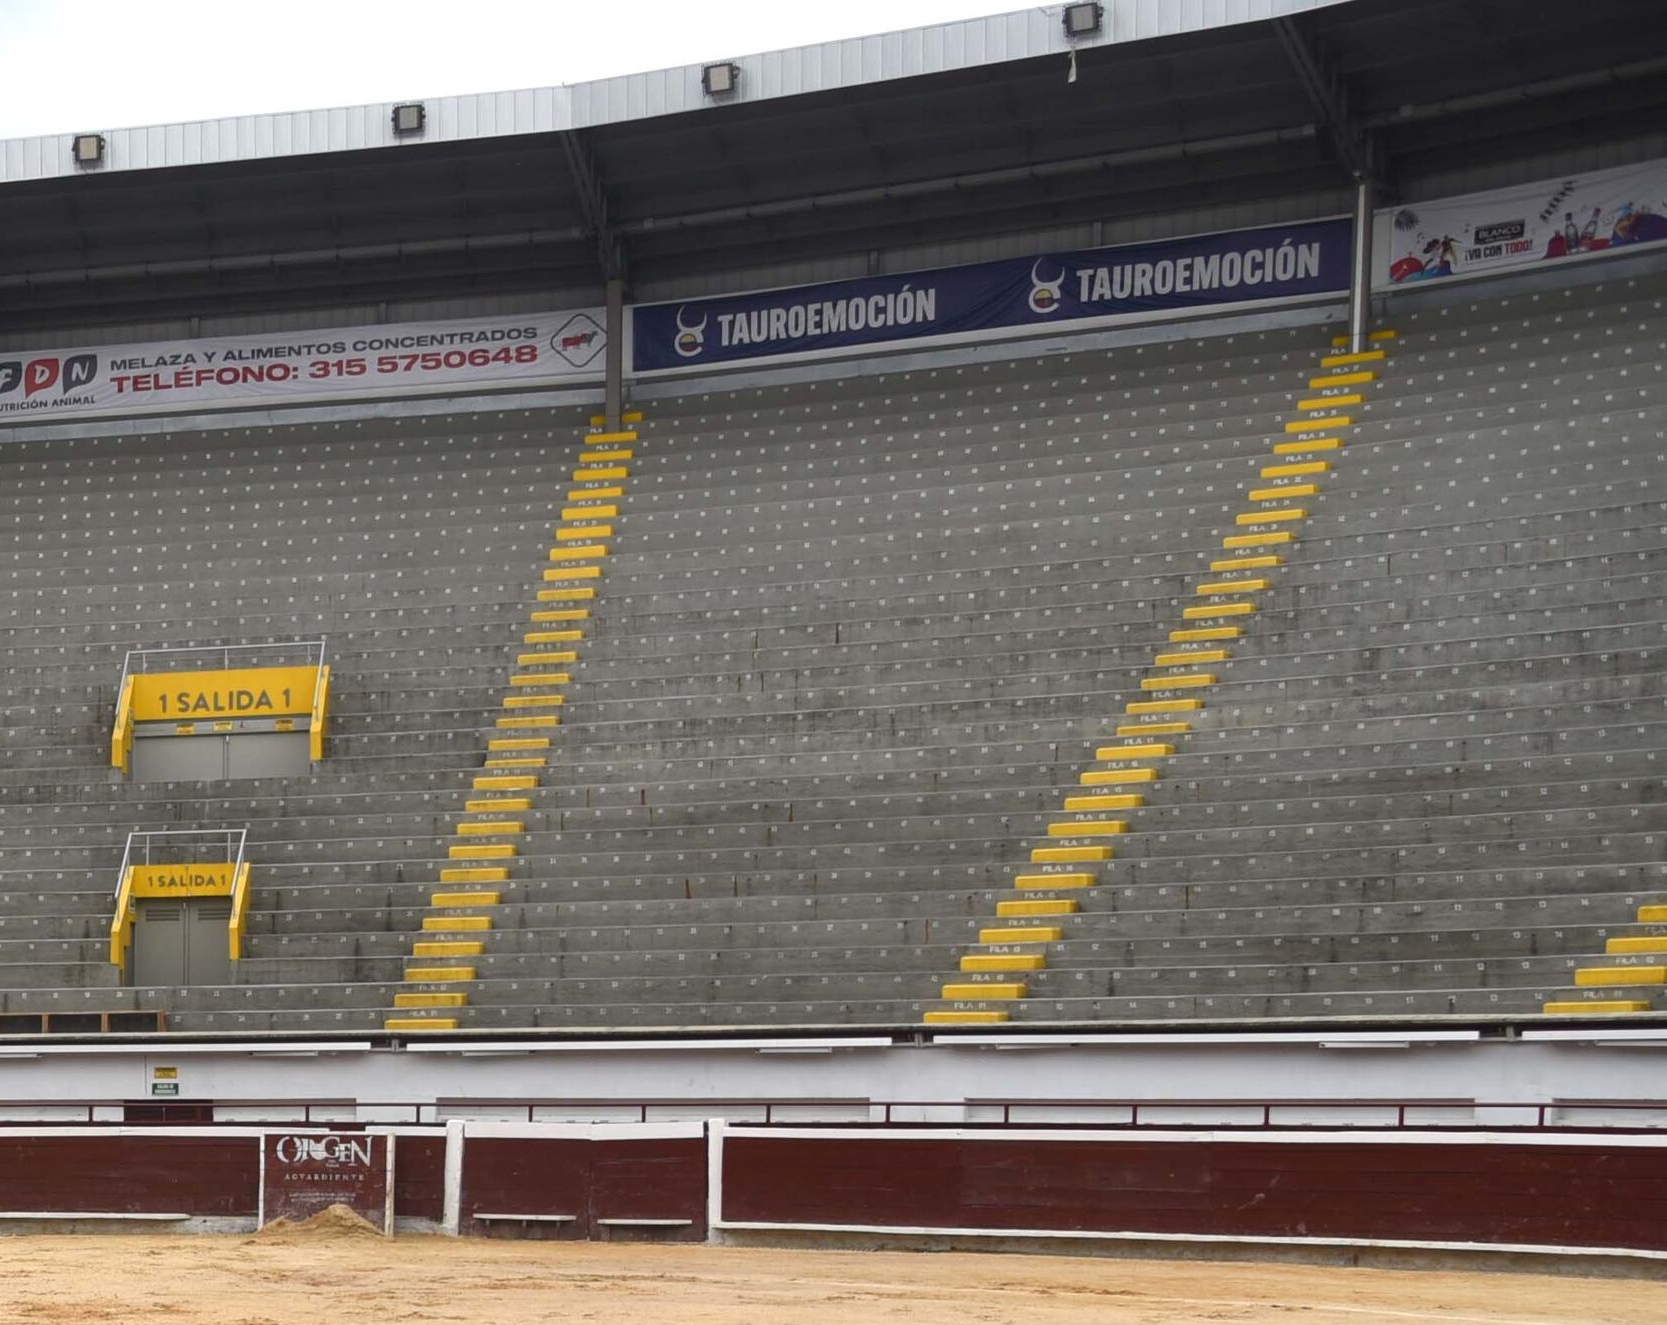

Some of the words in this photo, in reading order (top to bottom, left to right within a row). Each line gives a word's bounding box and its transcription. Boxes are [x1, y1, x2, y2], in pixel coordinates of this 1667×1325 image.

[1076, 238, 1322, 305] TAUROEMOCIÓN
[717, 284, 937, 348] TAUROEMOCIÓN
[110, 353, 197, 372] MELAZA
[203, 351, 217, 364] Y
[222, 341, 347, 362] ALIMENTOS
[352, 327, 539, 352] CONCENTRADOS
[110, 361, 300, 394] TELÉFONO:
[308, 358, 368, 381] 315
[376, 343, 539, 375] 5750648
[51, 395, 96, 409] ANIMAL
[158, 693, 167, 713] 1
[177, 689, 274, 713] SALIDA
[282, 687, 291, 708] 1
[147, 875, 154, 888] 1
[158, 873, 217, 888] SALIDA
[220, 873, 227, 886] 1
